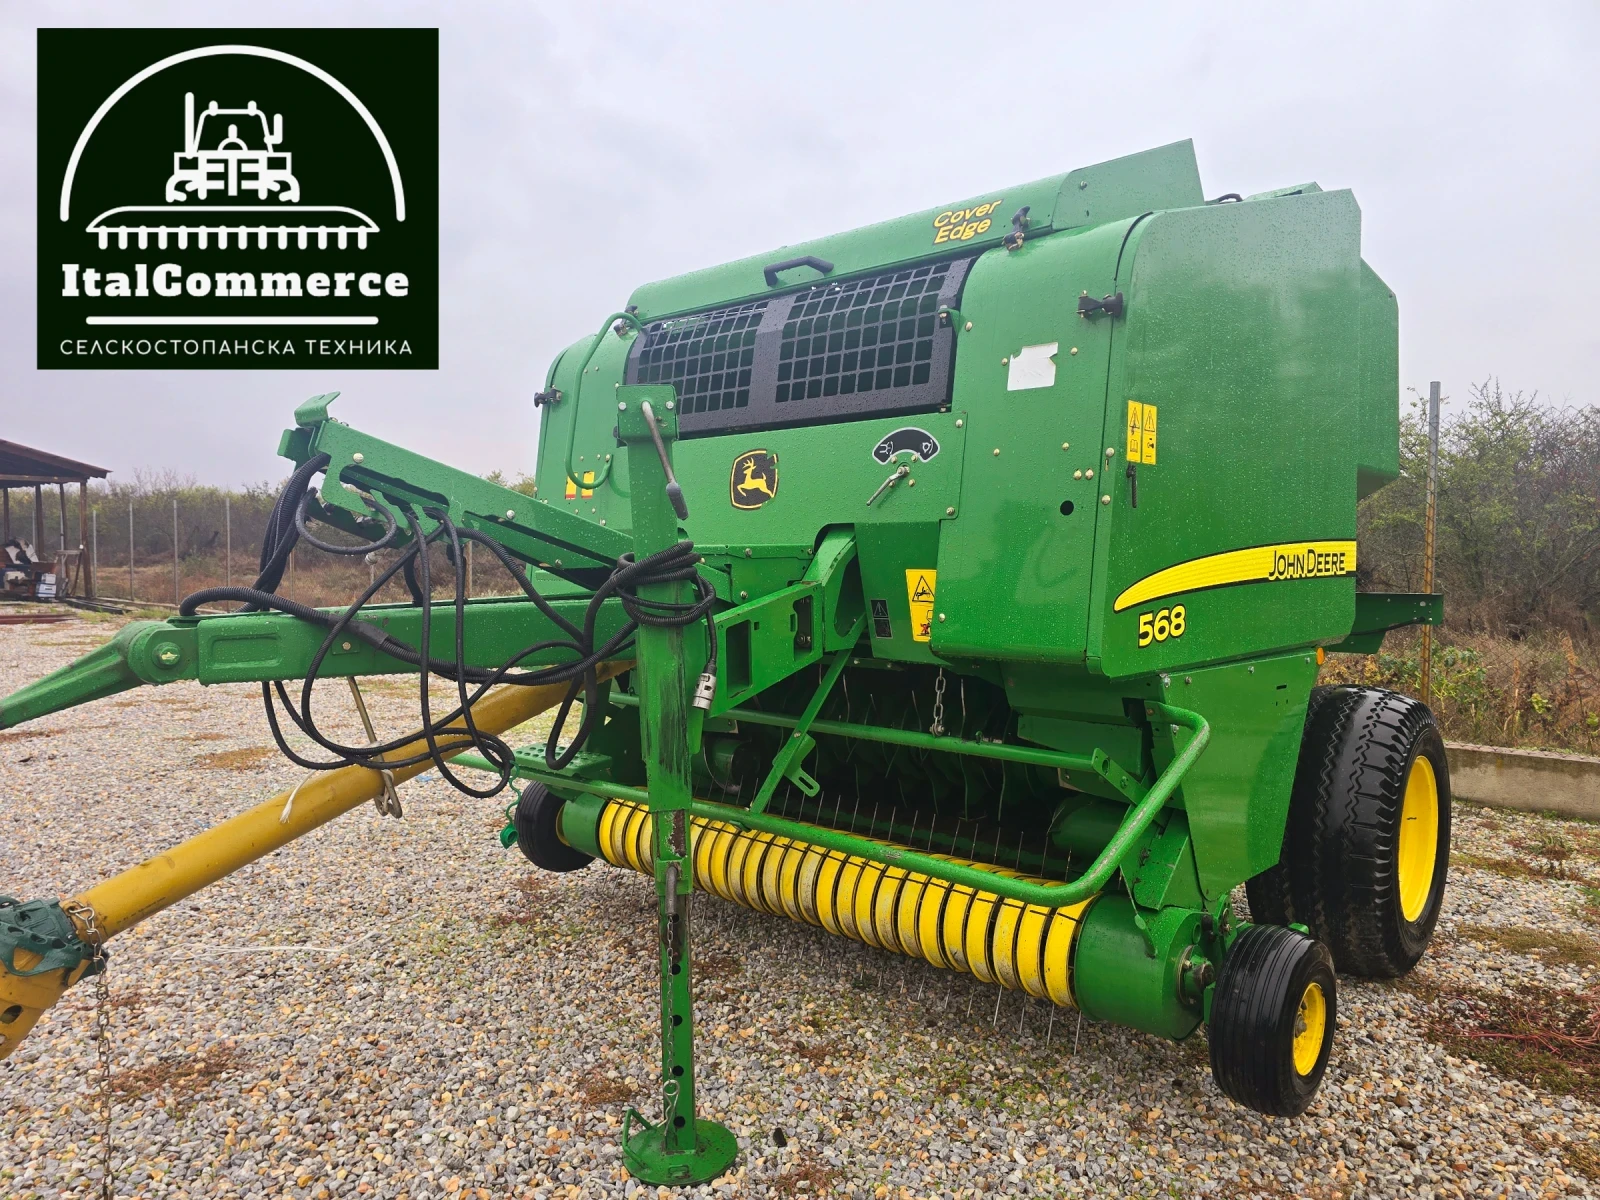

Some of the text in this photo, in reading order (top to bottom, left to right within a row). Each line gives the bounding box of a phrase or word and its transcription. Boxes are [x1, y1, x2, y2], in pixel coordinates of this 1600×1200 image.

[933, 199, 1003, 227] Cover
[933, 219, 992, 244] Edge
[1138, 604, 1187, 648] 568
